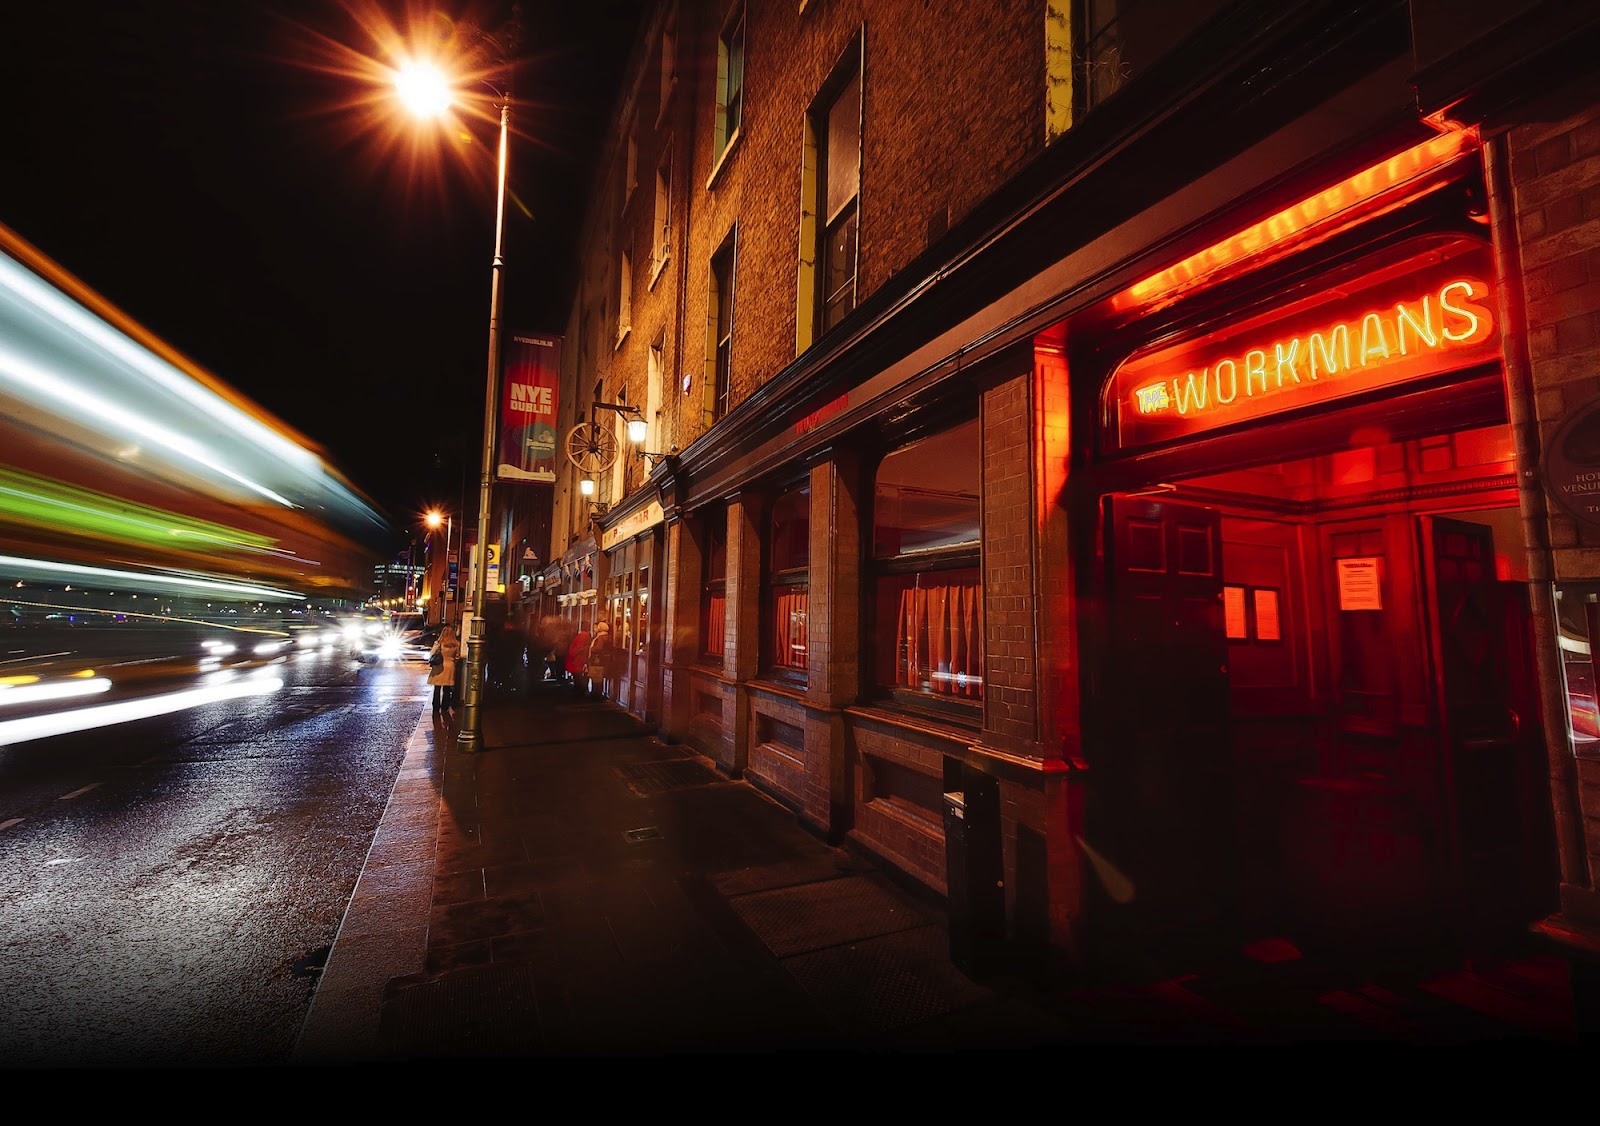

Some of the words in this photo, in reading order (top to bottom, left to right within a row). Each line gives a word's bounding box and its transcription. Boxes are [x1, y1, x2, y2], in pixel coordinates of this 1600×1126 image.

[1173, 279, 1488, 416] WORKMANS
[510, 382, 552, 404] NYE
[509, 399, 552, 415] DUBLIN
